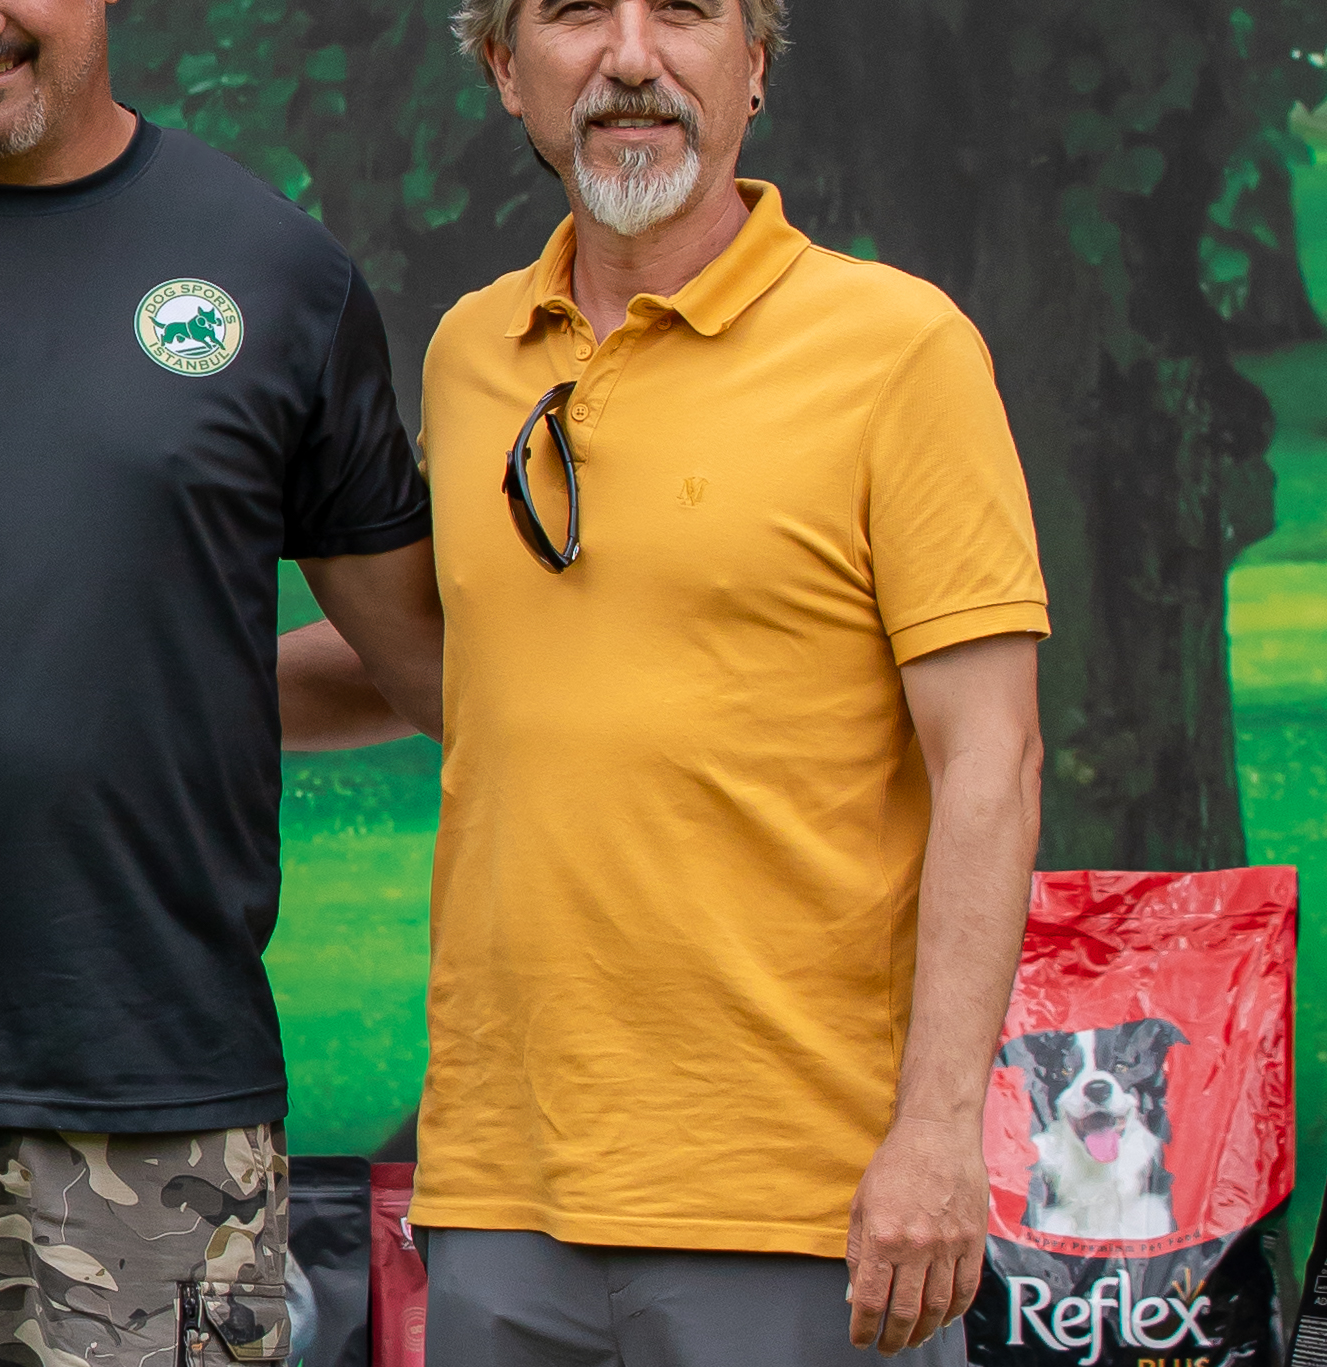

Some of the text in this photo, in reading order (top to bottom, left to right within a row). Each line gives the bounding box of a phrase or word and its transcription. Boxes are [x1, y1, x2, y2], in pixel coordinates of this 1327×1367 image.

[145, 284, 236, 324] DOG SPORTS
[149, 342, 230, 371] ISTANBUL
[1006, 1268, 1213, 1367] Reflex
